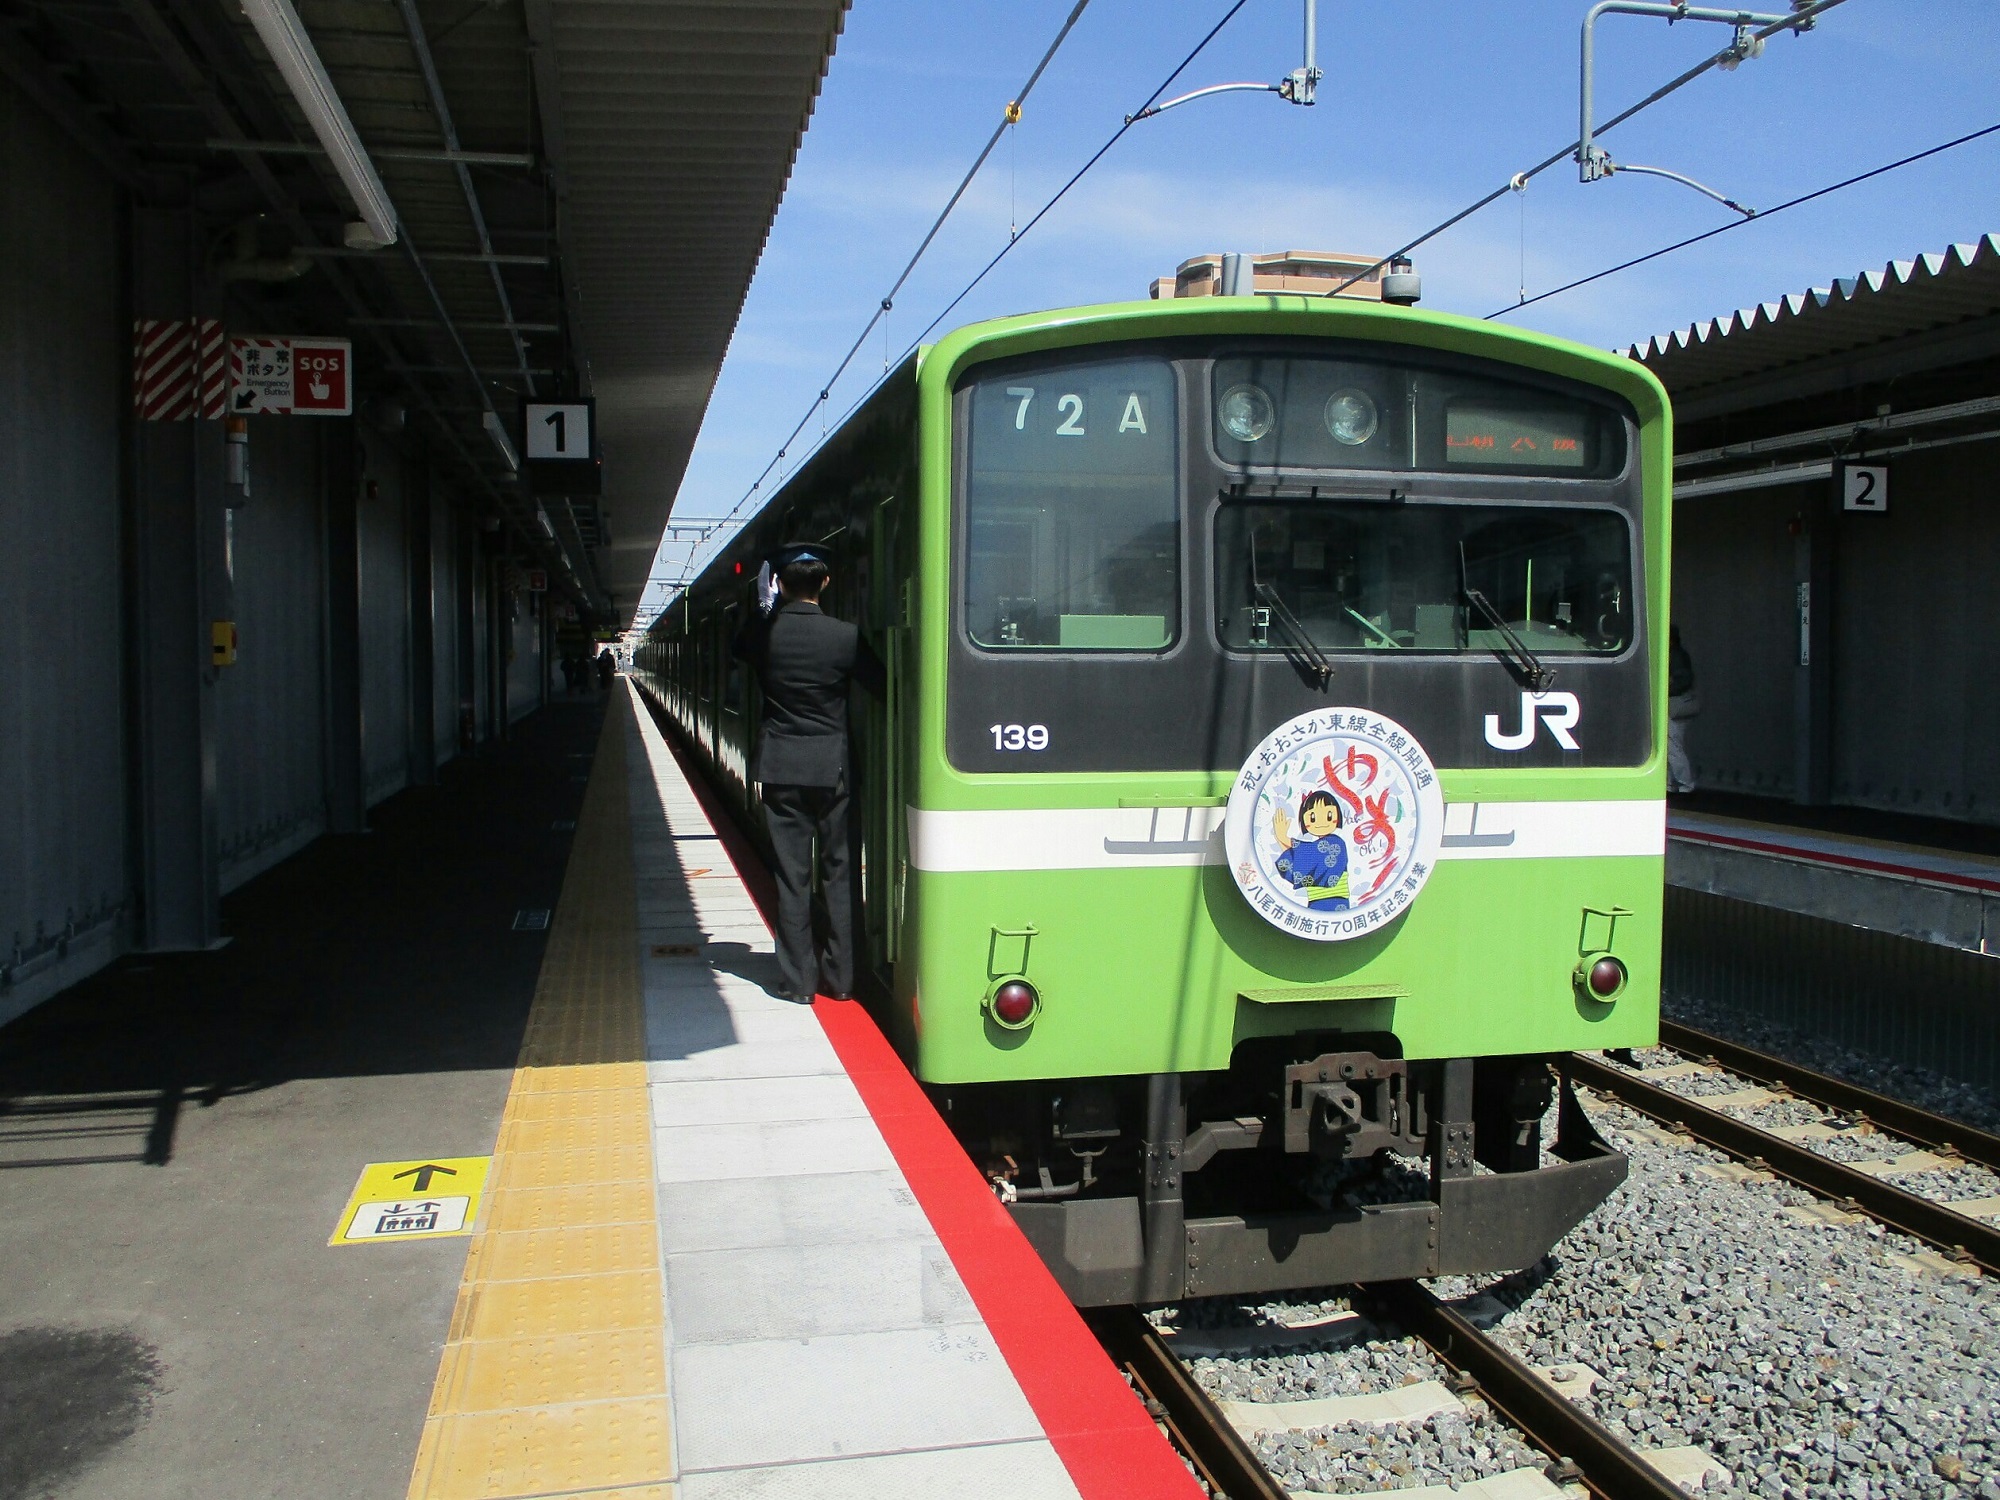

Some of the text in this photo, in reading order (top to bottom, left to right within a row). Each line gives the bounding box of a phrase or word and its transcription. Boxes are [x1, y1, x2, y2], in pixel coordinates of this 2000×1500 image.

[247, 363, 289, 376] ボタン
[299, 356, 340, 372] SOS
[246, 378, 290, 389] Emergency
[264, 387, 291, 396] Button
[544, 410, 565, 453] 1
[1855, 471, 1876, 506] 2
[1484, 691, 1580, 751] JR
[988, 723, 1049, 751] 139
[1247, 861, 1428, 936] 八尾市制施行70周年記念事業
